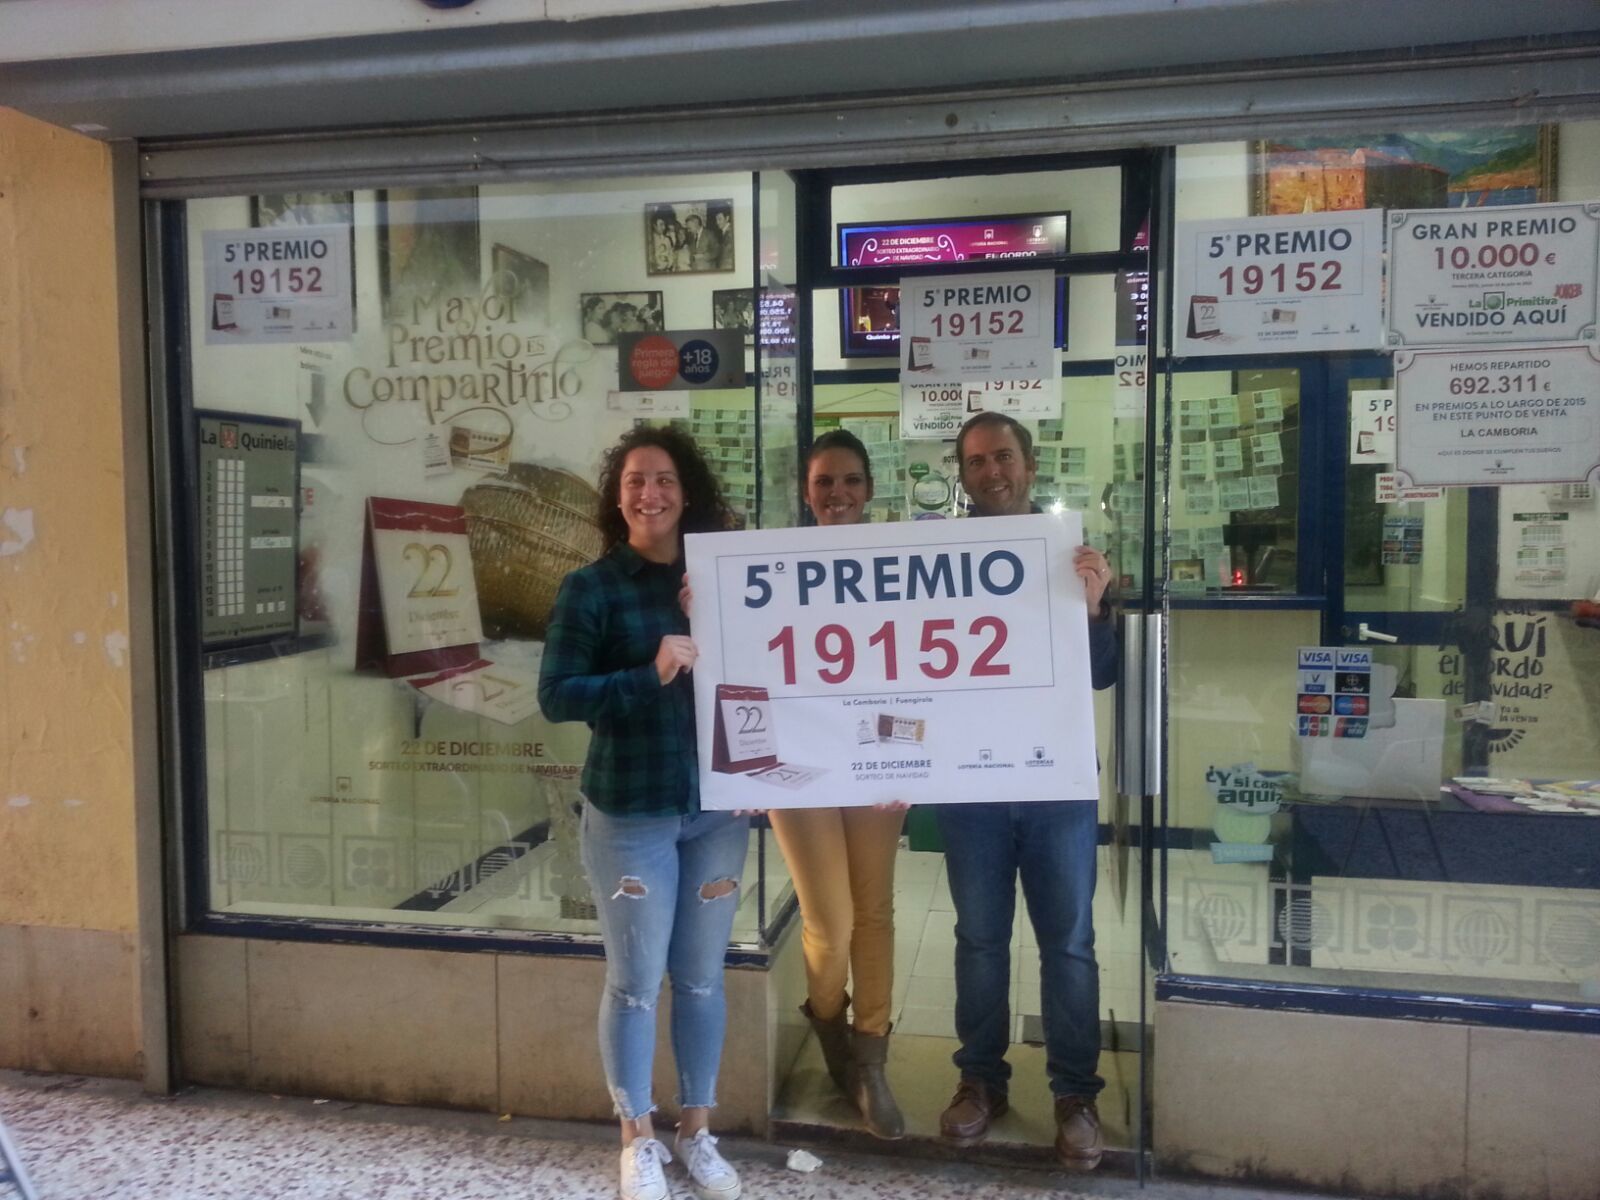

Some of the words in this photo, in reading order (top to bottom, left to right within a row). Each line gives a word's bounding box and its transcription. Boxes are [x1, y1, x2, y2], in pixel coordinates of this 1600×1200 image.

[1412, 223, 1477, 241] GRAN
[1487, 217, 1576, 238] PREMIO
[244, 239, 328, 262] PREMIO
[1236, 228, 1352, 257] PREMIO
[1434, 243, 1539, 270] 10.000
[1545, 253, 1556, 265] €
[233, 267, 322, 294] 19152
[1219, 260, 1342, 295] 19152
[1452, 272, 1485, 281] TERCERA
[944, 284, 1031, 306] PREMIO
[1506, 296, 1558, 307] Primitiva
[412, 284, 520, 334] Mayor
[1416, 311, 1505, 328] VENDIDO
[1513, 305, 1567, 326] AQUÍ
[931, 310, 1024, 337] 19152
[386, 323, 522, 369] Premio
[683, 349, 712, 365] +18
[1450, 362, 1488, 372] HEMOS
[1490, 359, 1550, 370] REPARTIDO
[685, 365, 711, 374] años
[1450, 374, 1537, 395] 692.311
[1415, 403, 1429, 411] EN
[1432, 401, 1478, 411] PREMIOS
[1480, 401, 1488, 409] A
[1490, 400, 1504, 409] LO
[1507, 399, 1544, 409] LARGO
[1546, 399, 1561, 407] DE
[1563, 397, 1586, 407] 2015
[1433, 412, 1447, 421] EN
[1450, 411, 1473, 421] ESTE
[1476, 410, 1512, 420] PUNTO
[1515, 410, 1529, 419] DE
[1533, 409, 1567, 418] VENTA
[913, 421, 954, 431] VENDIDO
[1461, 429, 1475, 438] LA
[1478, 427, 1538, 437] CAMBORIA
[201, 428, 217, 445] La
[241, 432, 297, 452] Quiniela
[403, 542, 460, 599] 22
[797, 549, 1025, 606] PREMIO
[768, 615, 1011, 685] 19152
[1304, 652, 1332, 663] VISA
[1340, 653, 1369, 664] VISA
[1438, 655, 1459, 676] el
[1442, 680, 1465, 696] de
[853, 698, 887, 706] Camboria
[895, 696, 933, 705] Fuengirola
[736, 705, 767, 735] 22
[401, 741, 423, 756] 22
[426, 741, 447, 757] DE
[449, 741, 545, 758] DICIEMBRE
[369, 761, 410, 772] SORTEO
[413, 761, 509, 774] EXTRAORDINARIO
[511, 763, 525, 774] DE
[526, 764, 578, 777] NAVIDAD
[851, 762, 864, 771] 22
[865, 761, 880, 770] DE
[880, 759, 932, 769] DICIEMBRE
[855, 773, 884, 781] SORTEO
[896, 771, 929, 780] NAVIDAD
[1233, 776, 1250, 788] si
